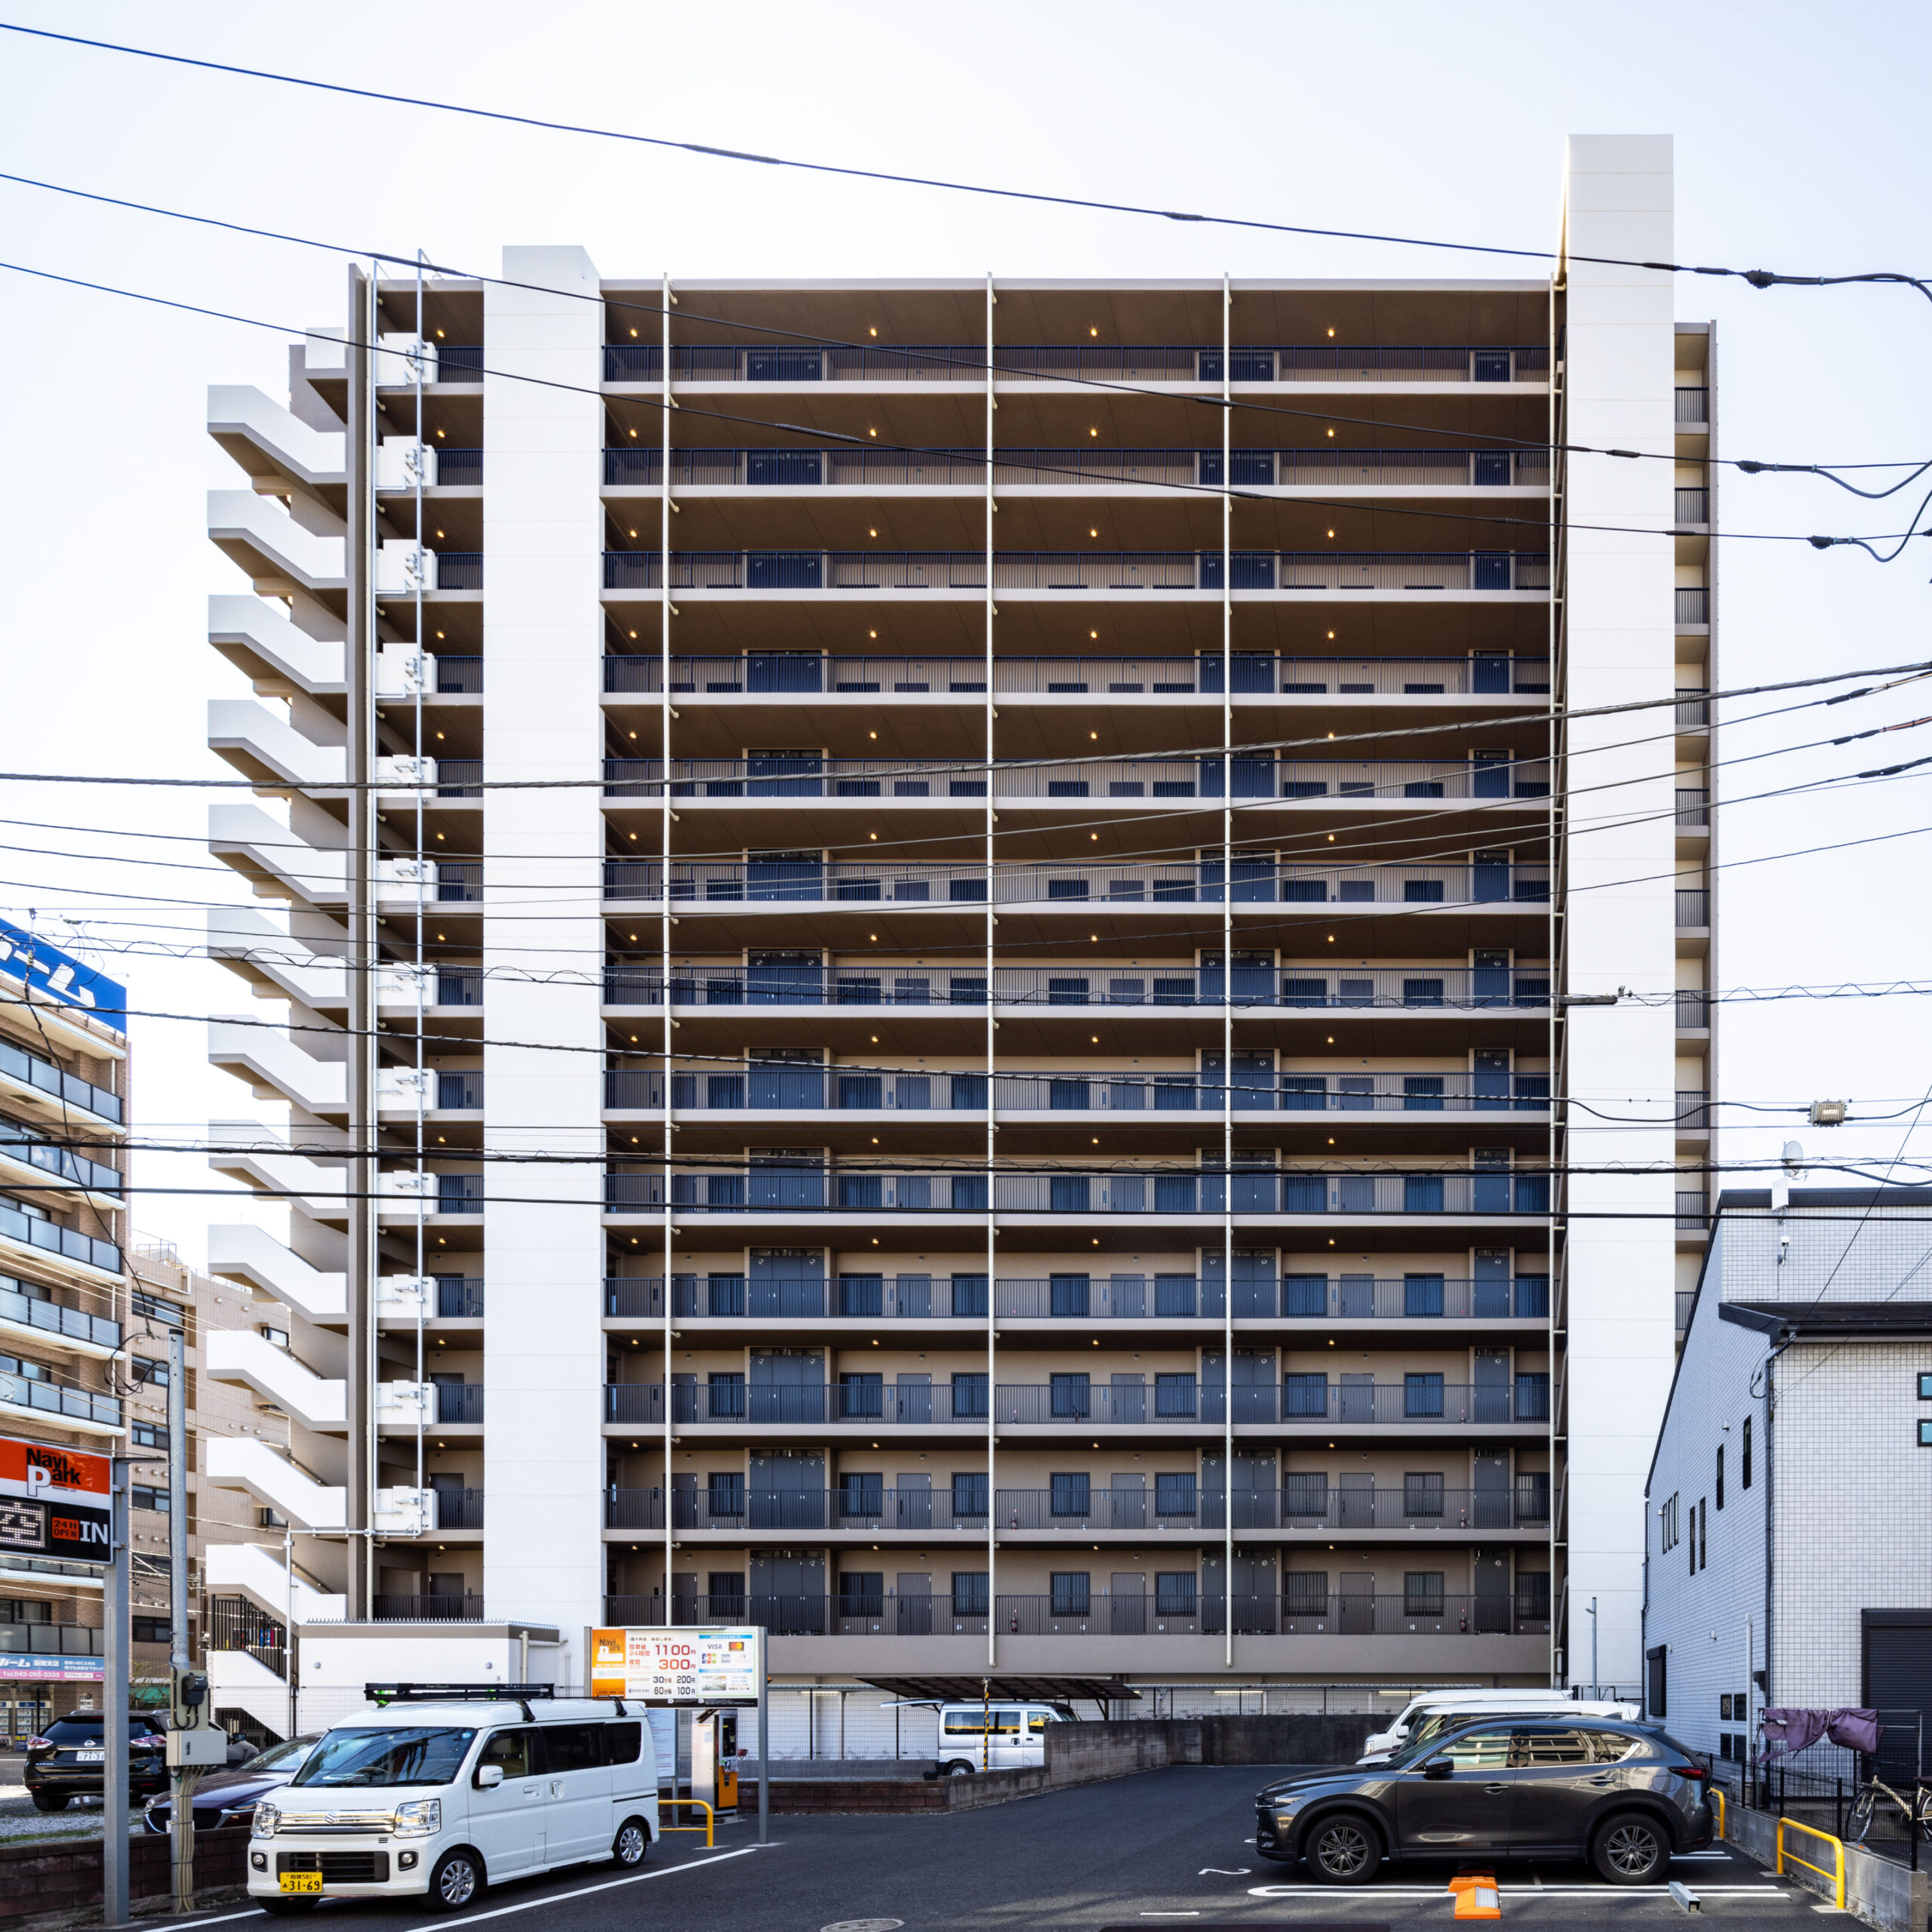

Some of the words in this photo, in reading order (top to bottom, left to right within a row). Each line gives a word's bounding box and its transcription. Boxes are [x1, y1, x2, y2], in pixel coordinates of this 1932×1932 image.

[26, 1447, 68, 1470] Navi
[27, 1464, 81, 1497] Park
[54, 1531, 77, 1539] OPEN
[80, 1520, 109, 1545] IN
[599, 1638, 616, 1647] Navi
[655, 1644, 696, 1656] 1100円
[659, 1659, 696, 1669] 300円
[676, 1675, 696, 1684] 200円
[677, 1687, 696, 1695] 100円
[289, 1880, 320, 1890] 31-69
